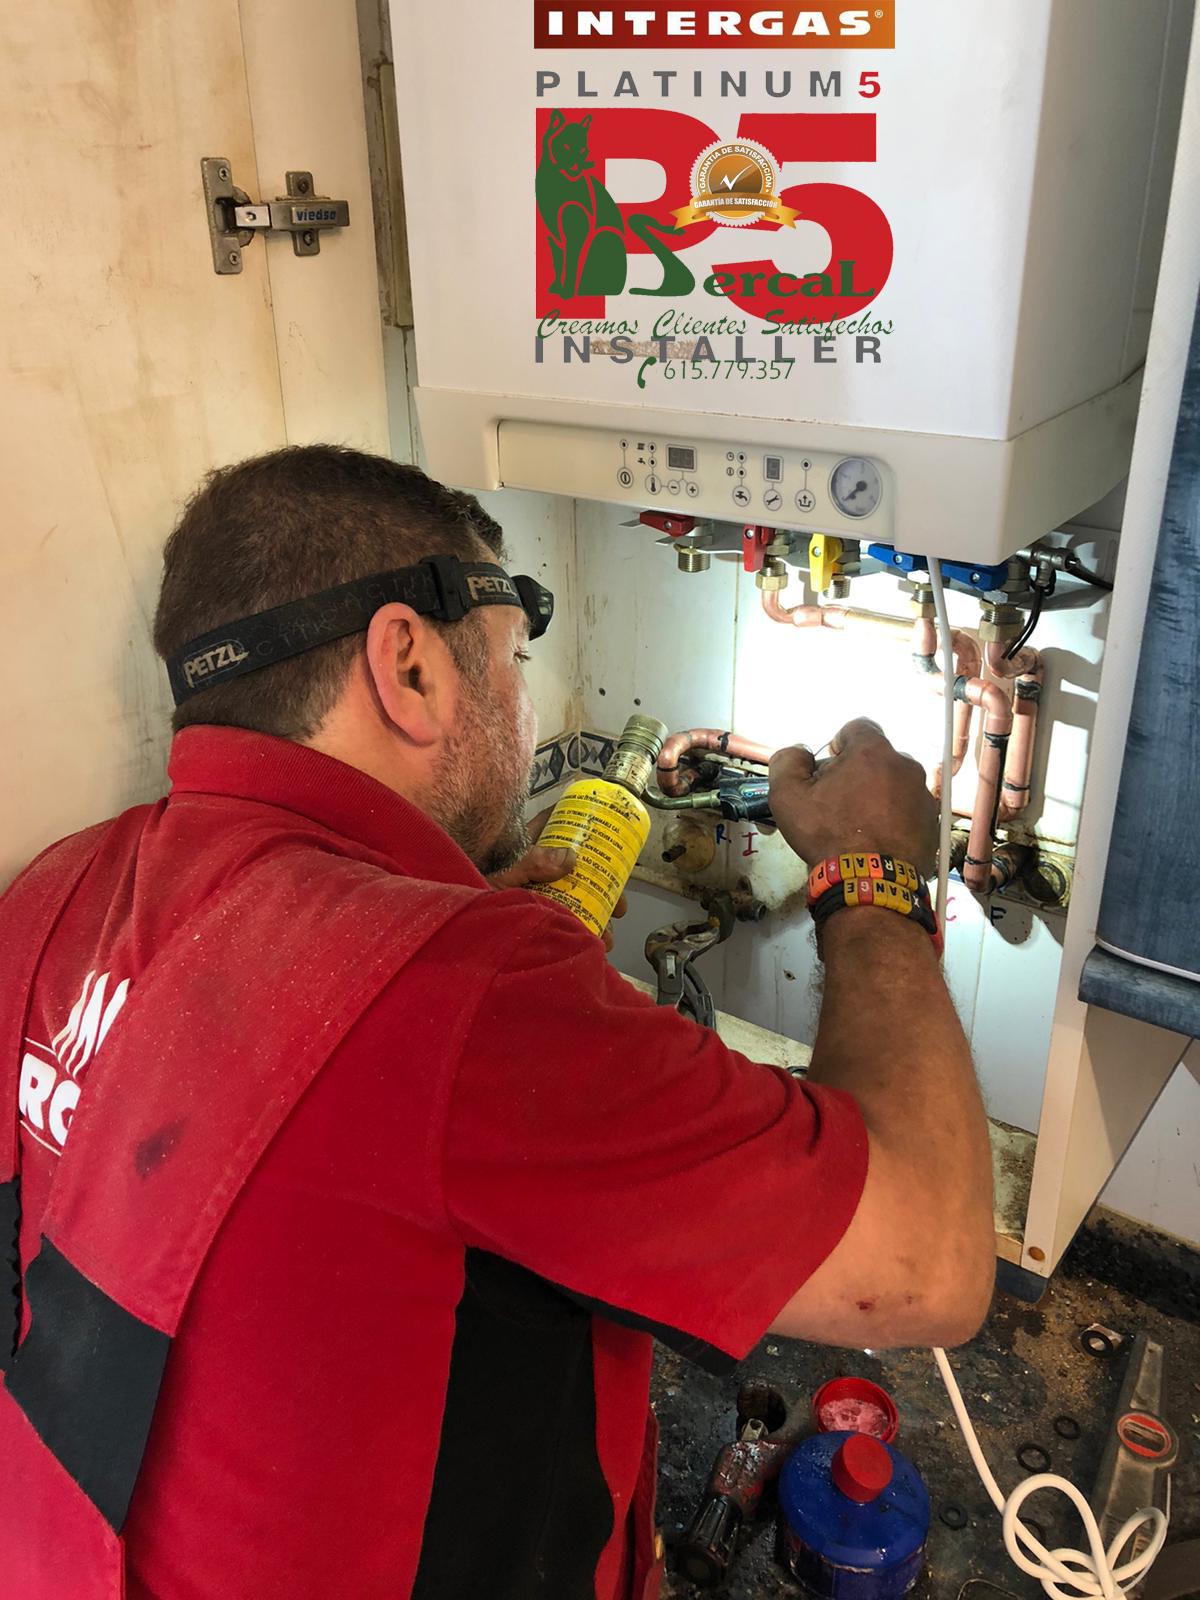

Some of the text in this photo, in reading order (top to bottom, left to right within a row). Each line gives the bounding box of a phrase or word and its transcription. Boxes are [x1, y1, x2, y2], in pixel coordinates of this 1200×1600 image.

[183, 643, 250, 688] PETZL
[716, 823, 732, 845] R
[842, 857, 917, 881] SERCAL
